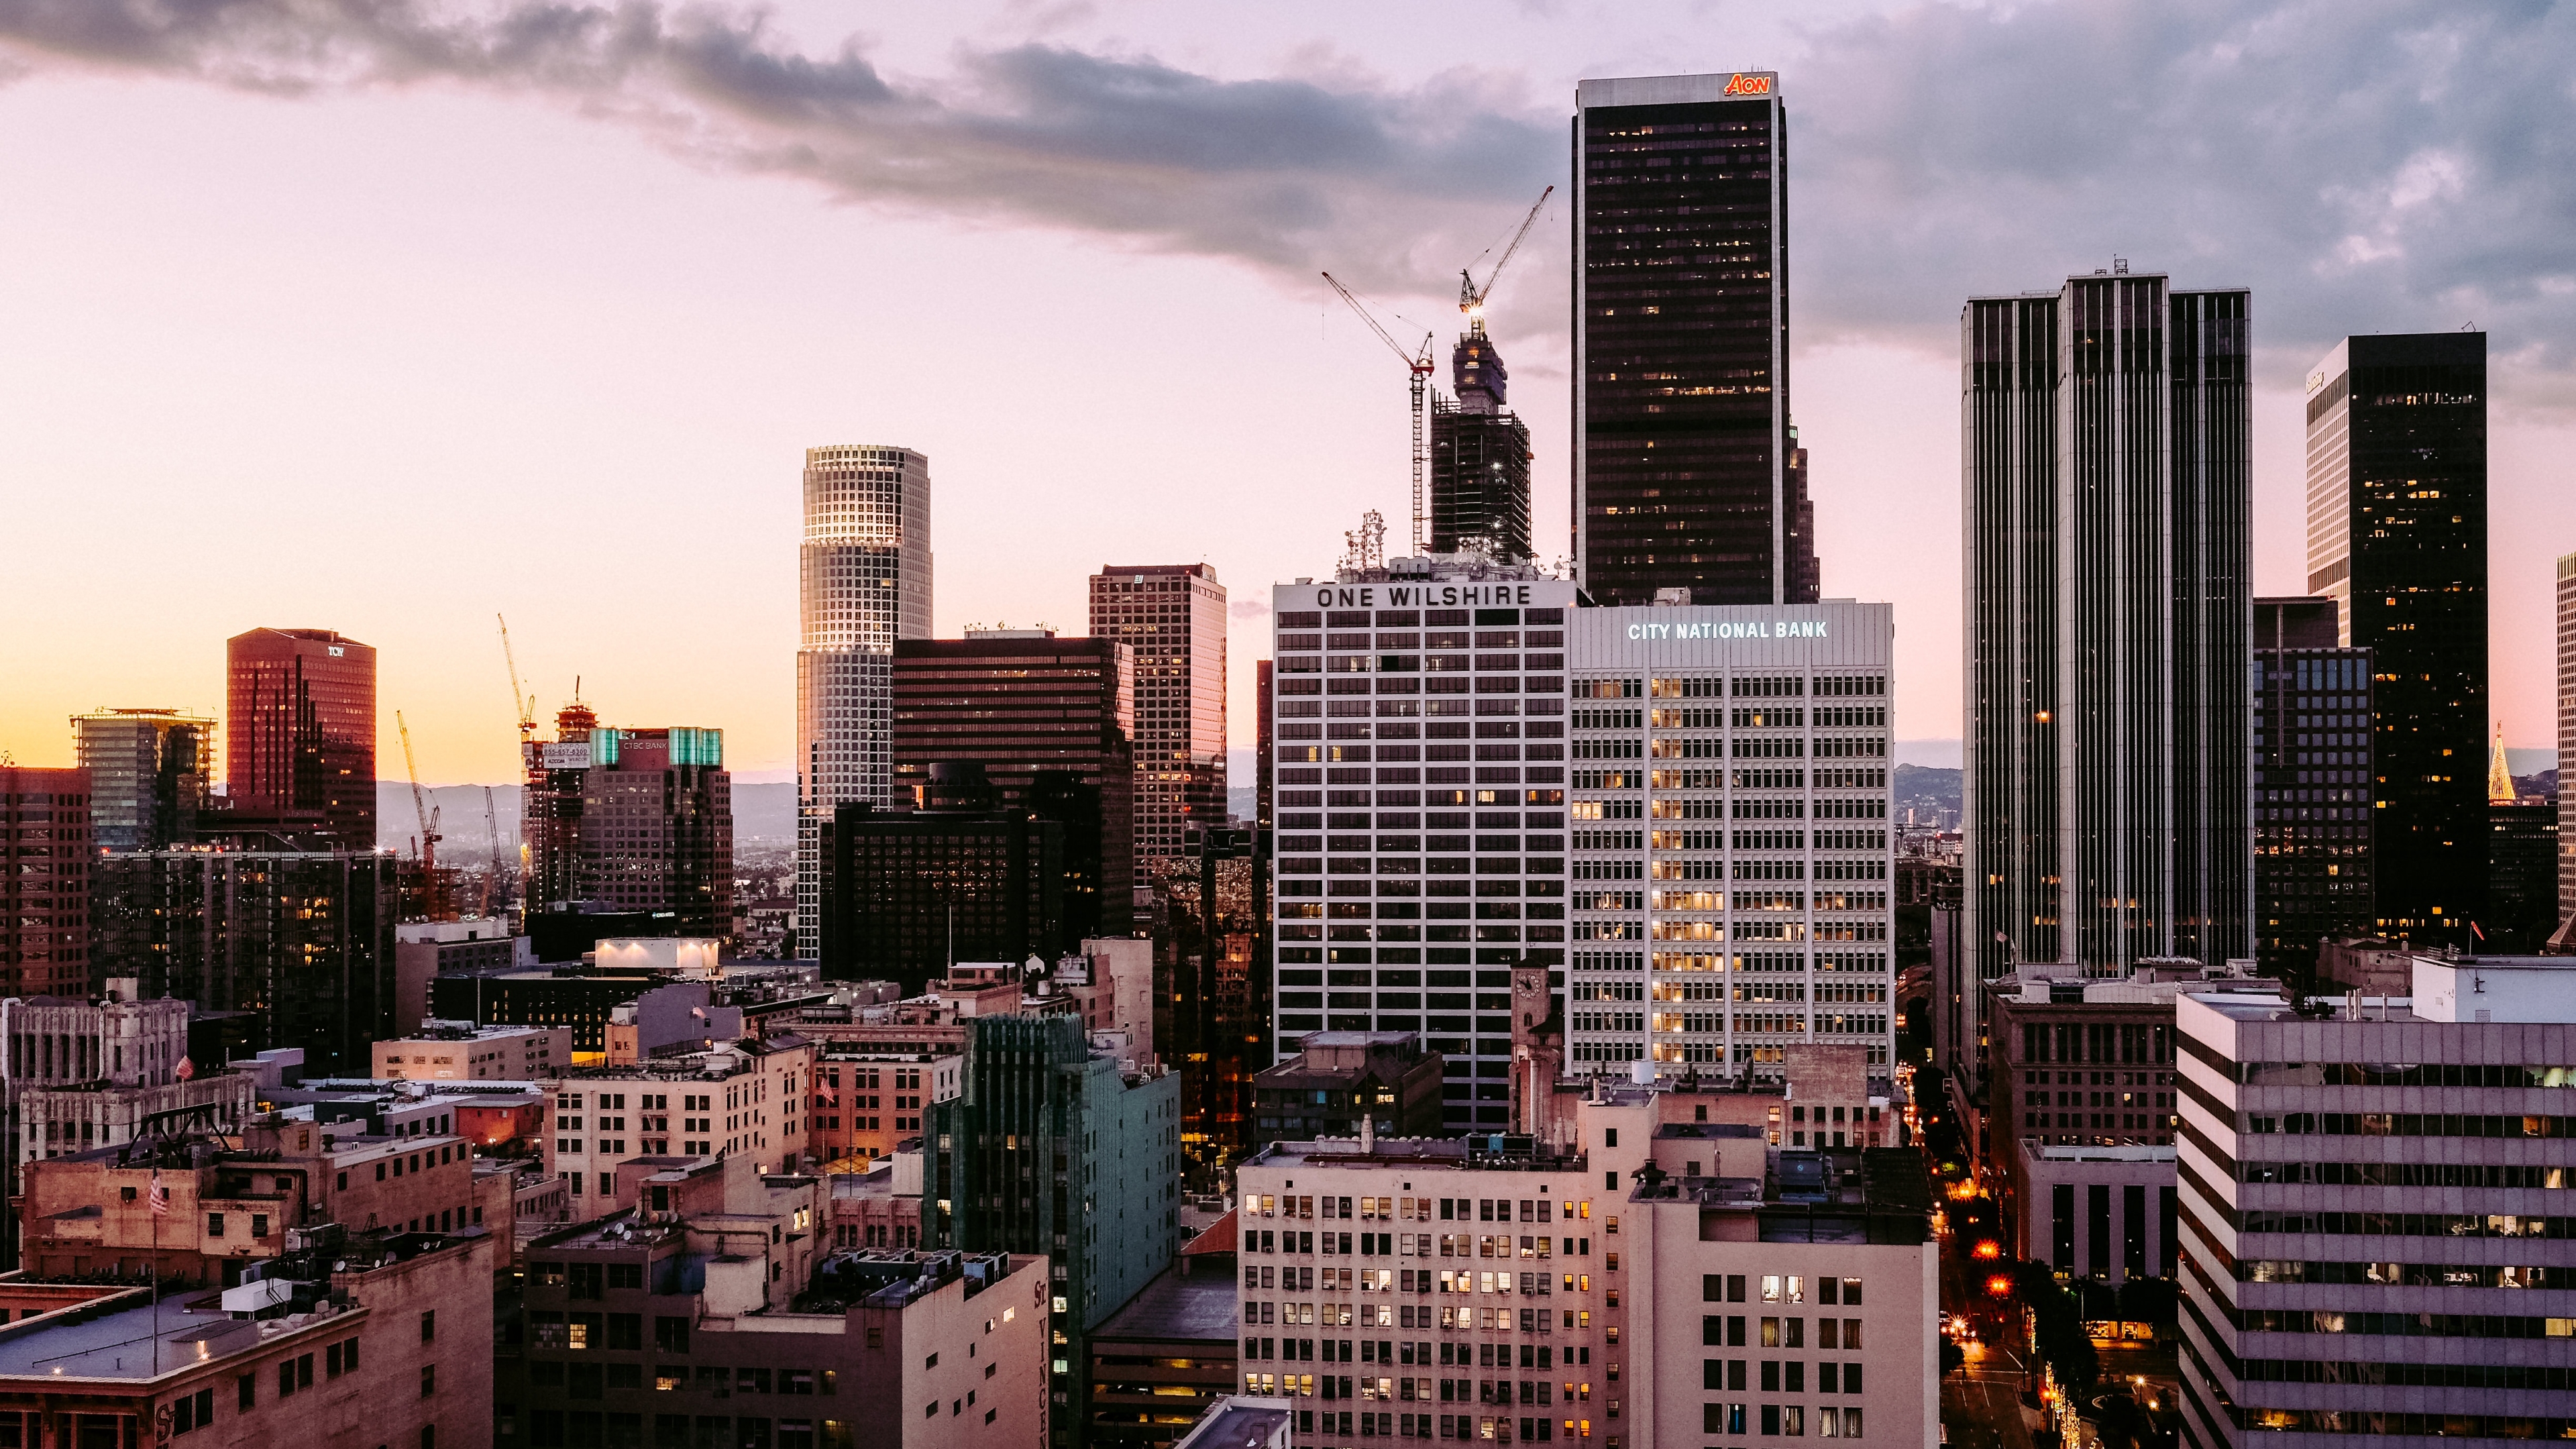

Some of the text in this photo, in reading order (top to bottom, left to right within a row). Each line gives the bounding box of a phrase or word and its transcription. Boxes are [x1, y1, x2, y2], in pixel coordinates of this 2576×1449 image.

[1318, 586, 1530, 607] ONE WILSHIRE
[1627, 621, 1827, 639] CITY NATIONAL BANK
